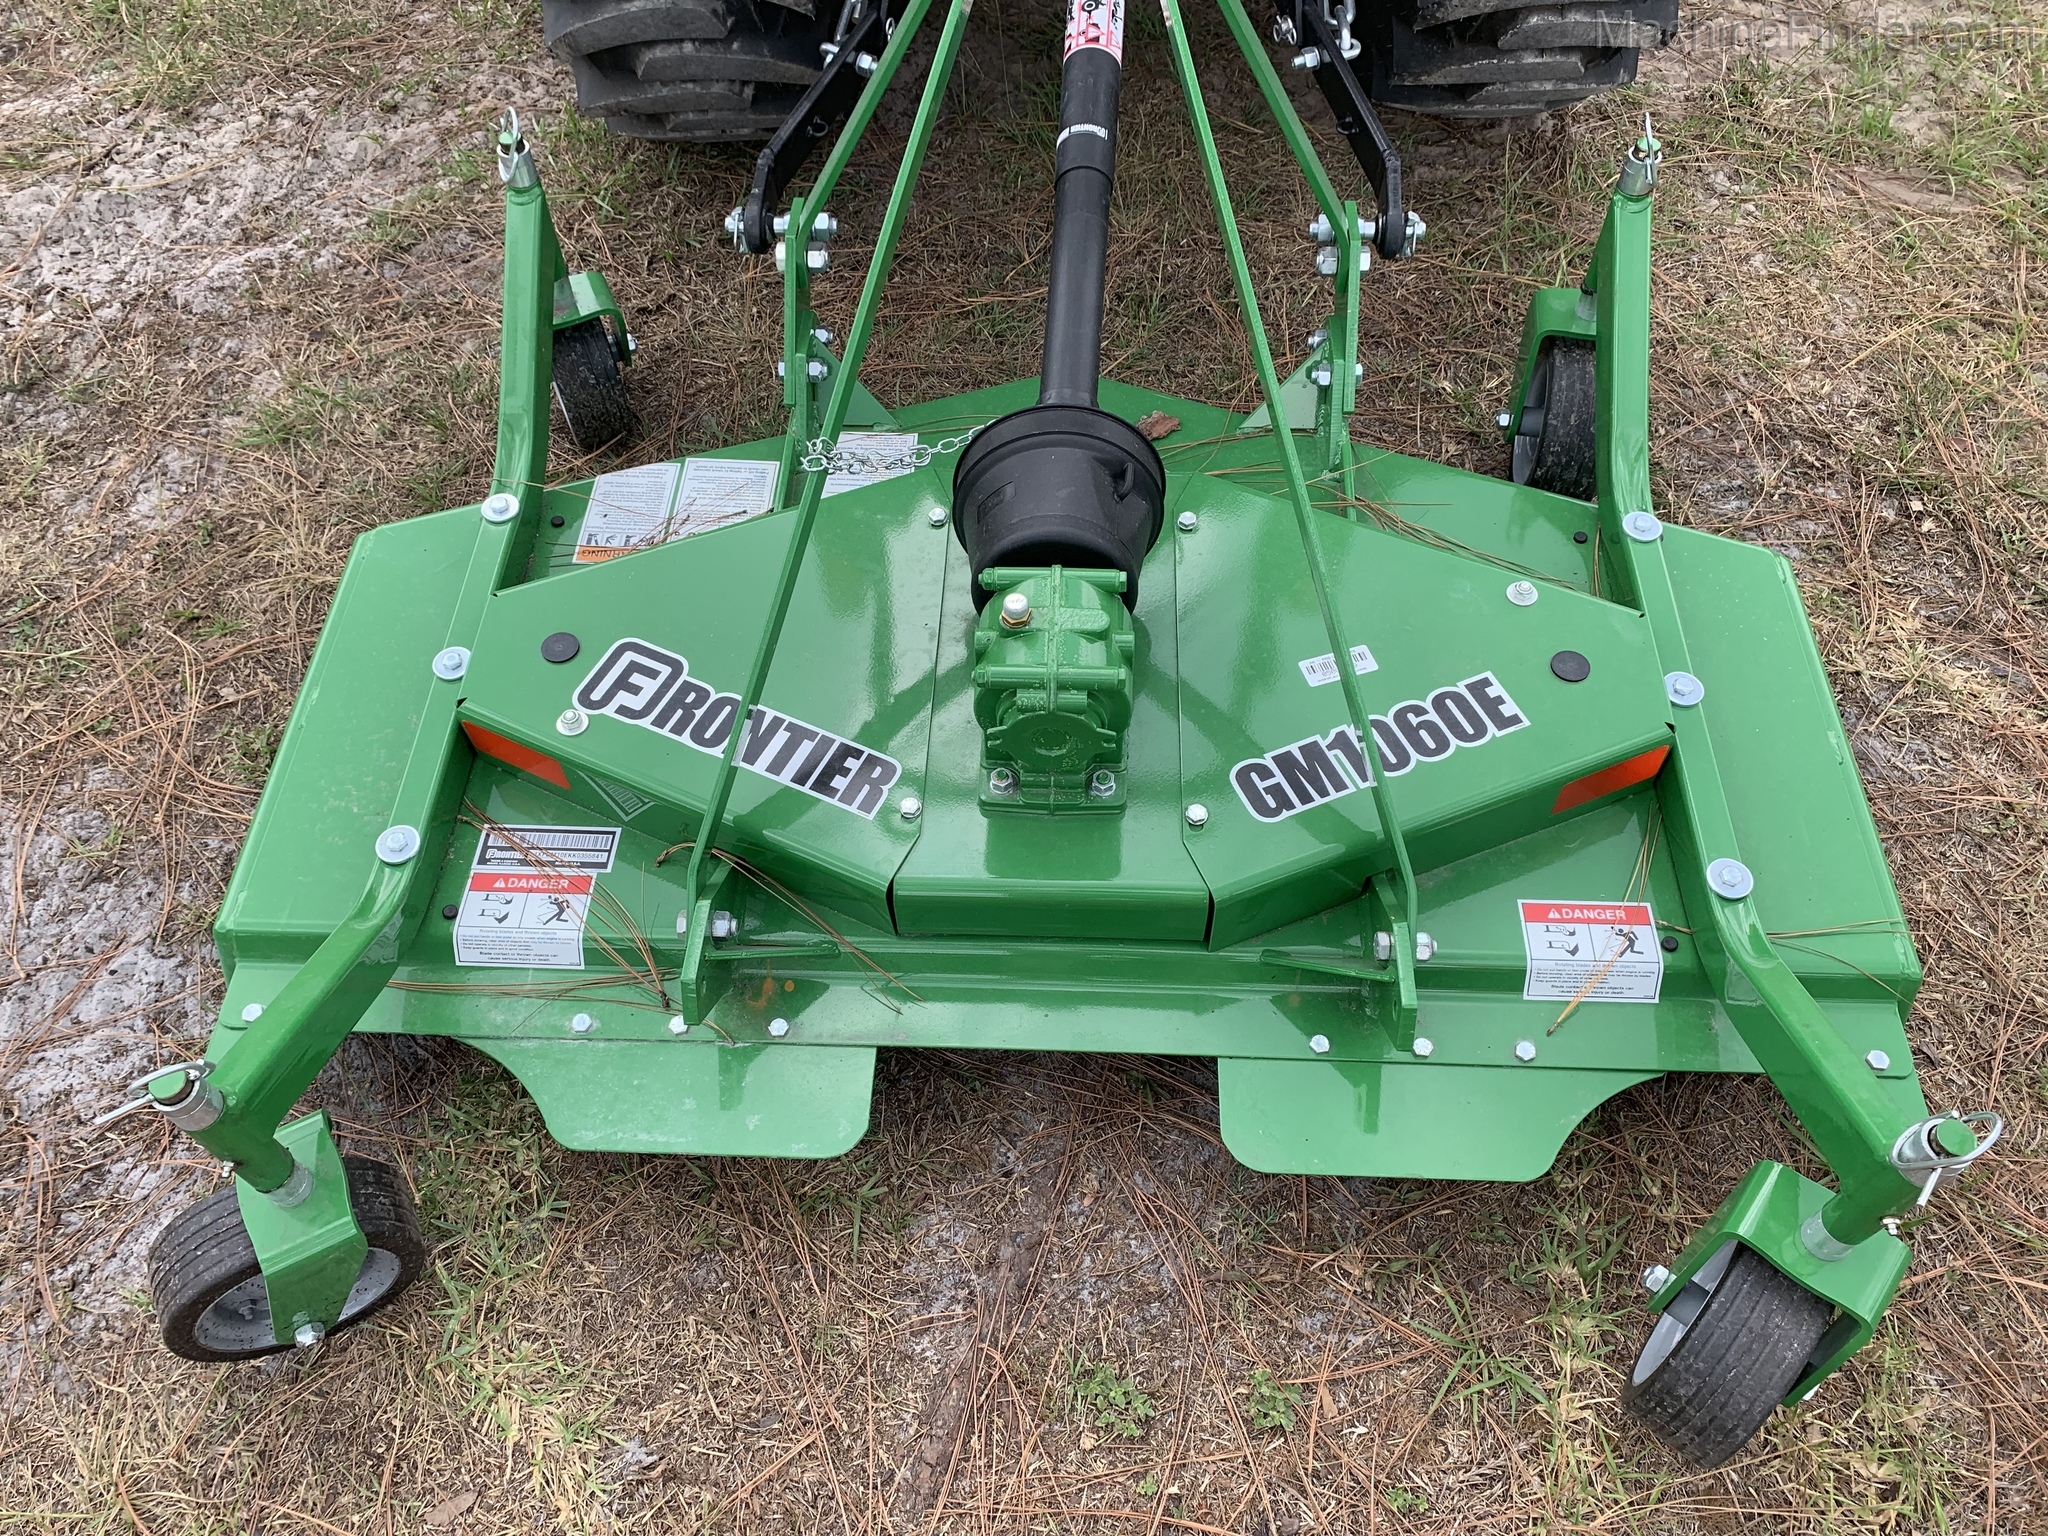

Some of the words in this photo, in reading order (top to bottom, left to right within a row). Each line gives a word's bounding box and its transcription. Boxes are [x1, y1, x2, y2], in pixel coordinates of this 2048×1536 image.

[576, 639, 901, 818] FRONTIER
[1232, 674, 1525, 819] GM1060E
[507, 878, 569, 889] DANGER
[1562, 908, 1626, 920] DANGER
